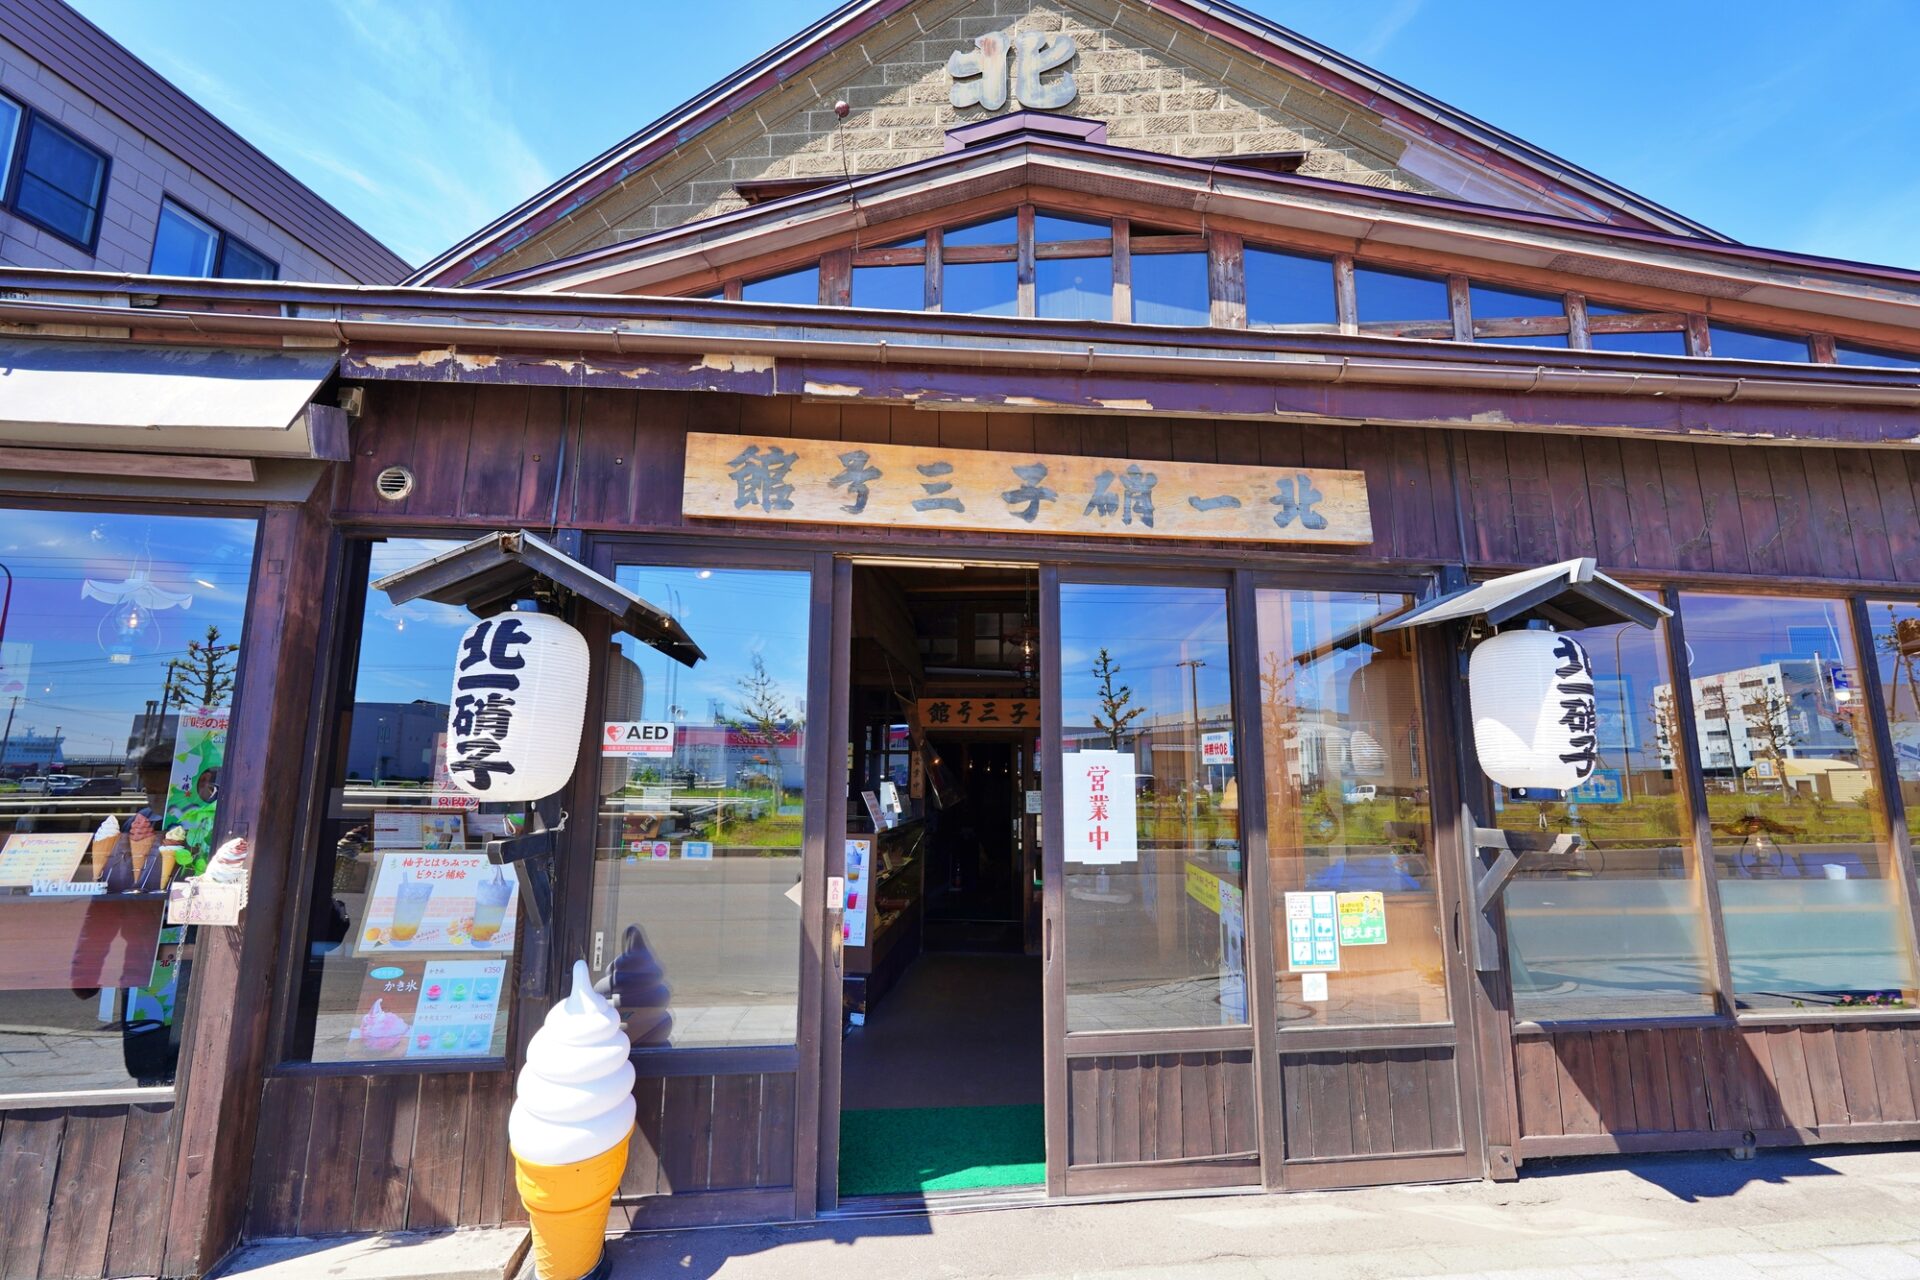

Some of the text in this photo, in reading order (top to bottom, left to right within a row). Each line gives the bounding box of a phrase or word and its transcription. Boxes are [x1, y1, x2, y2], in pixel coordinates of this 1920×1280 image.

[948, 31, 1077, 111] 北
[450, 618, 532, 790] 北一硝子
[626, 726, 668, 739] AED
[1086, 766, 1110, 850] 営業中
[402, 857, 480, 867] 柚子とはちみつで
[416, 869, 467, 880] ビタミン補給
[31, 879, 104, 893] Welcome
[384, 979, 419, 992] かき氷
